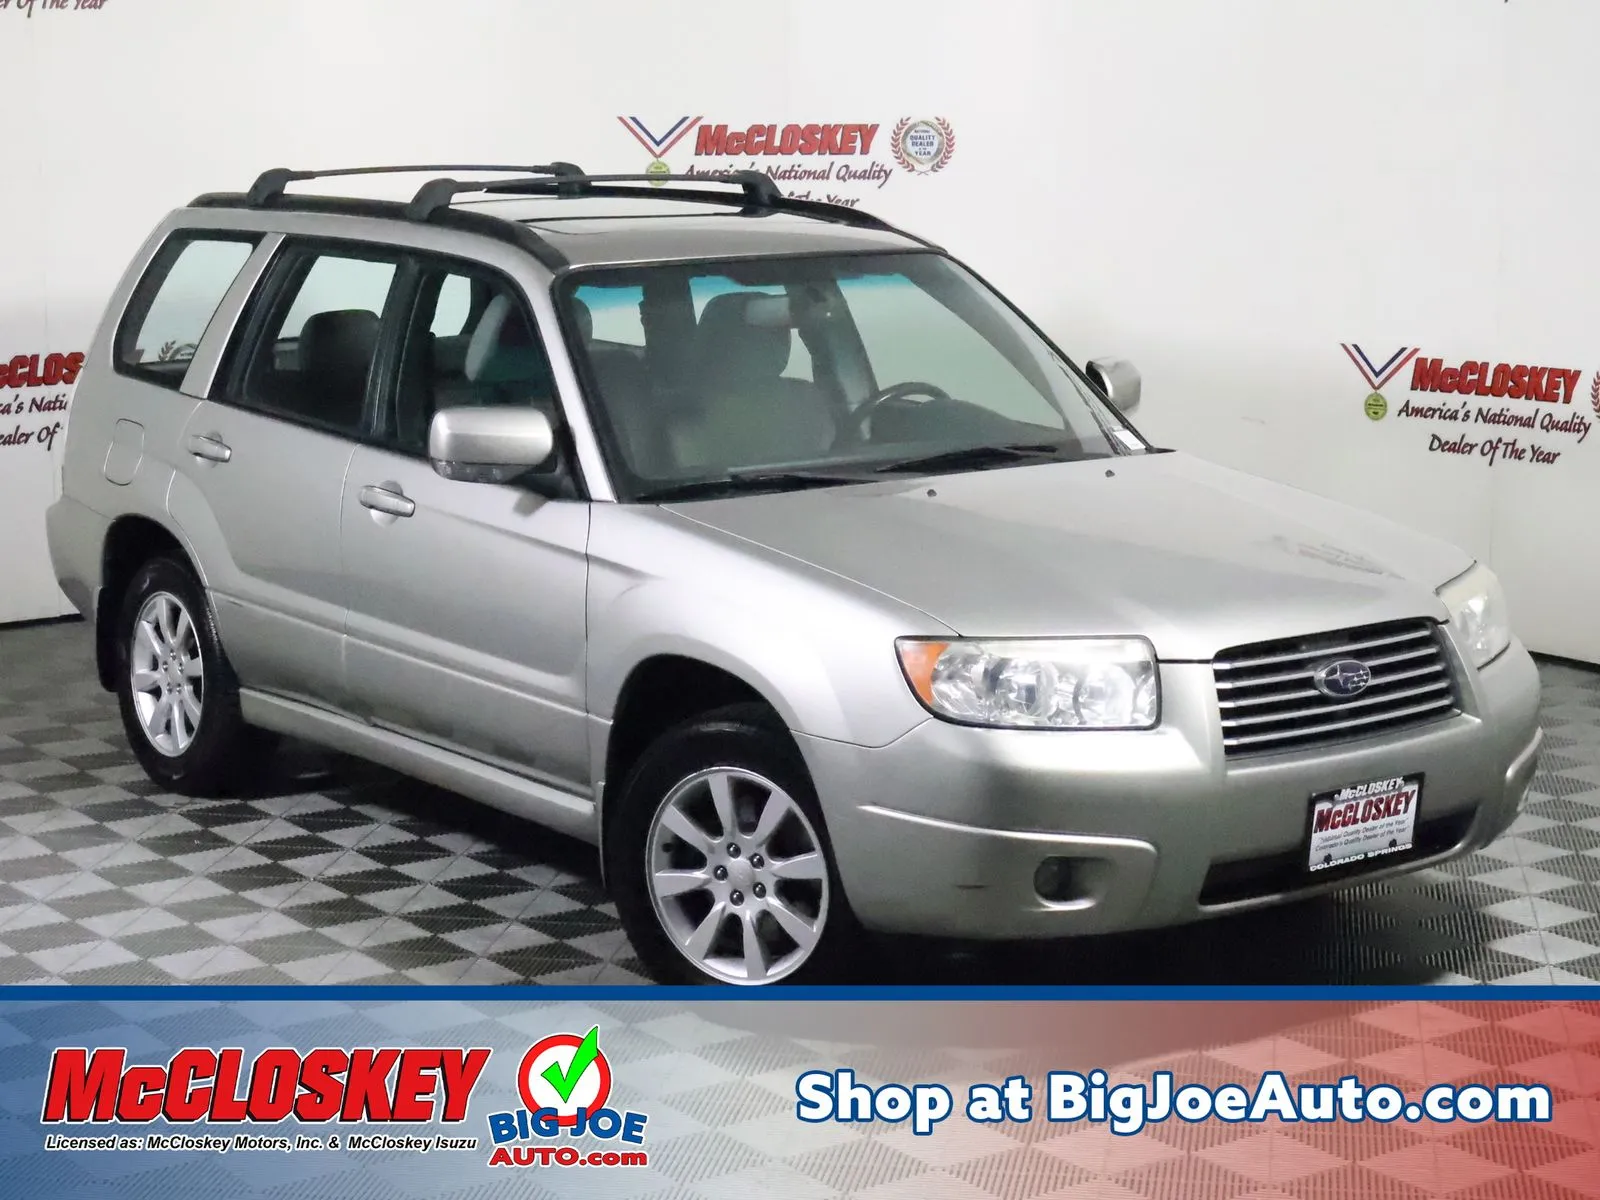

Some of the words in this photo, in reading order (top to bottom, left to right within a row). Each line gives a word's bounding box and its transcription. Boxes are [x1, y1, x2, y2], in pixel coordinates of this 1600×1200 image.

[695, 123, 880, 156] McCLOSKEY
[766, 161, 831, 181] National
[836, 161, 894, 189] Quality
[1411, 357, 1582, 404] McCLOSKEY
[37, 421, 61, 451] Of
[1397, 400, 1471, 423] America's
[1474, 407, 1540, 430] National
[1540, 411, 1592, 443] Quality
[1428, 434, 1478, 455] Dealer
[1480, 437, 1502, 466] Of
[1502, 439, 1525, 461] The
[1529, 444, 1561, 465] Year
[1340, 777, 1403, 800] McCLOSKEY
[1314, 789, 1416, 833] McCLOSKEY
[1309, 853, 1365, 872] COLORADO
[1367, 843, 1413, 858] SPRINGS
